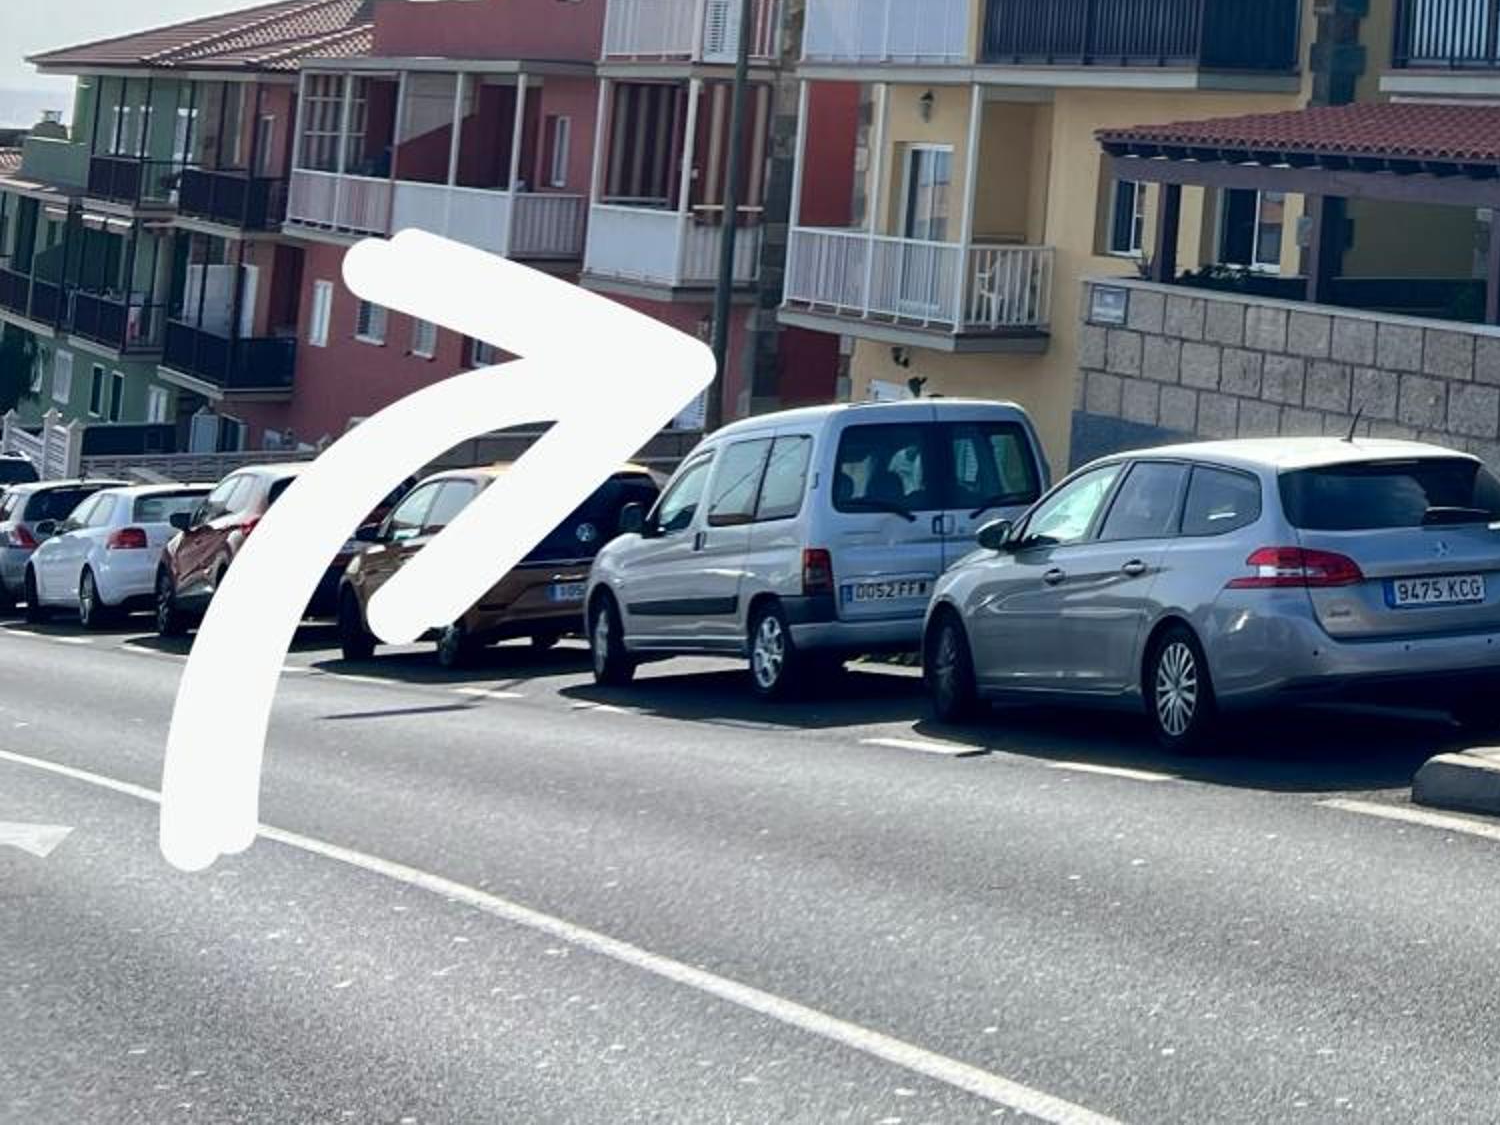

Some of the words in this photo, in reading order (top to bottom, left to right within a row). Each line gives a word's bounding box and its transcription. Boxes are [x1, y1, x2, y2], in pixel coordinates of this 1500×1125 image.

[856, 582, 896, 601] 0052
[1398, 580, 1442, 602] 9475
[1448, 578, 1481, 599] KCG
